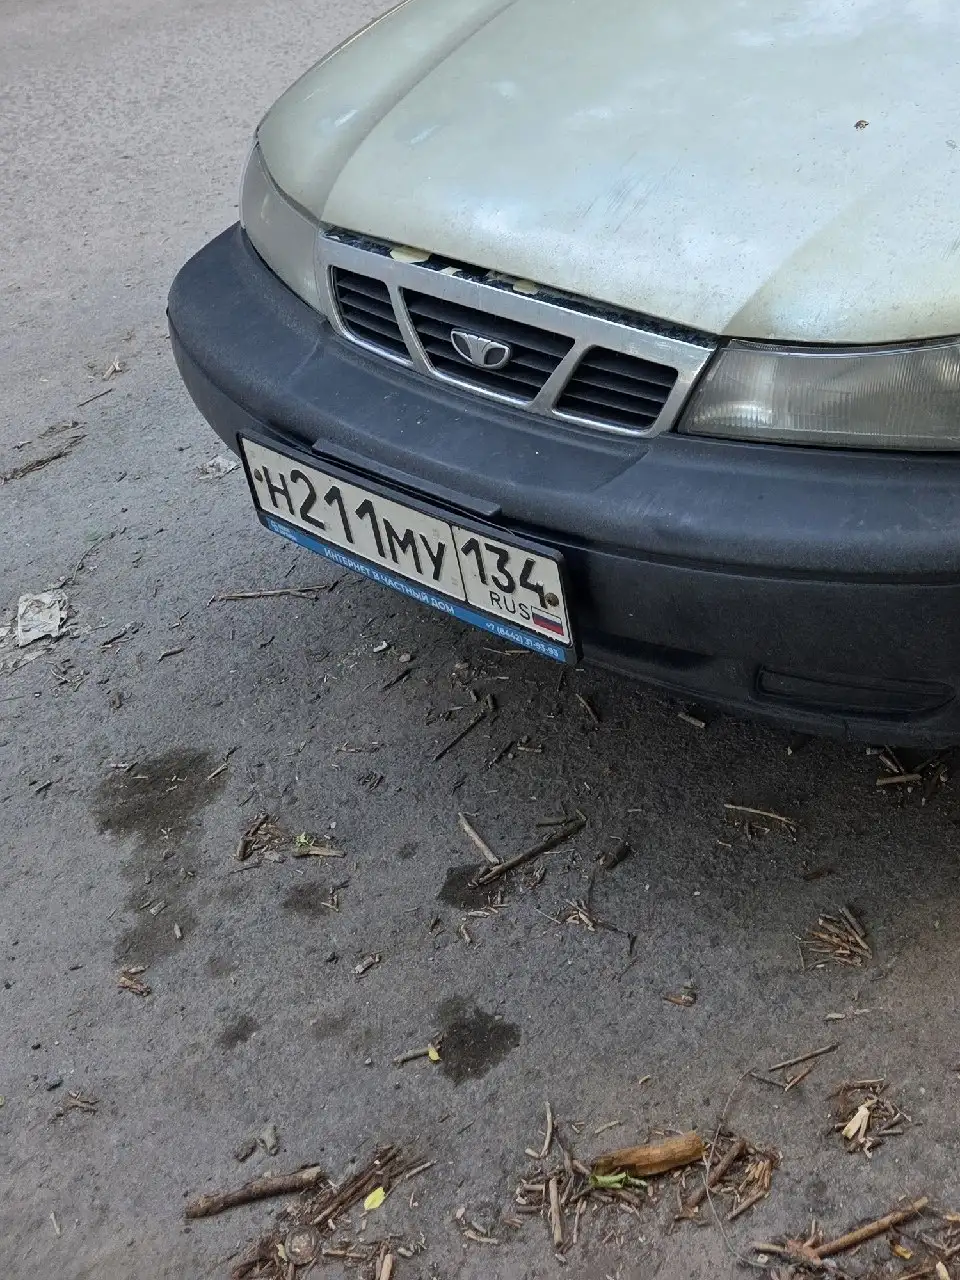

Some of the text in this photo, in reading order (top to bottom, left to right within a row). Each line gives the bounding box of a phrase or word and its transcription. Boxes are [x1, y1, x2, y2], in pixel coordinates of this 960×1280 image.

[262, 466, 548, 609] Н211МУ 134
[323, 547, 371, 577] ИНТЕРНЕТ
[380, 574, 429, 604] ЧАСТНЫЙ
[430, 596, 456, 616] ДОМ
[489, 591, 531, 621] RUS
